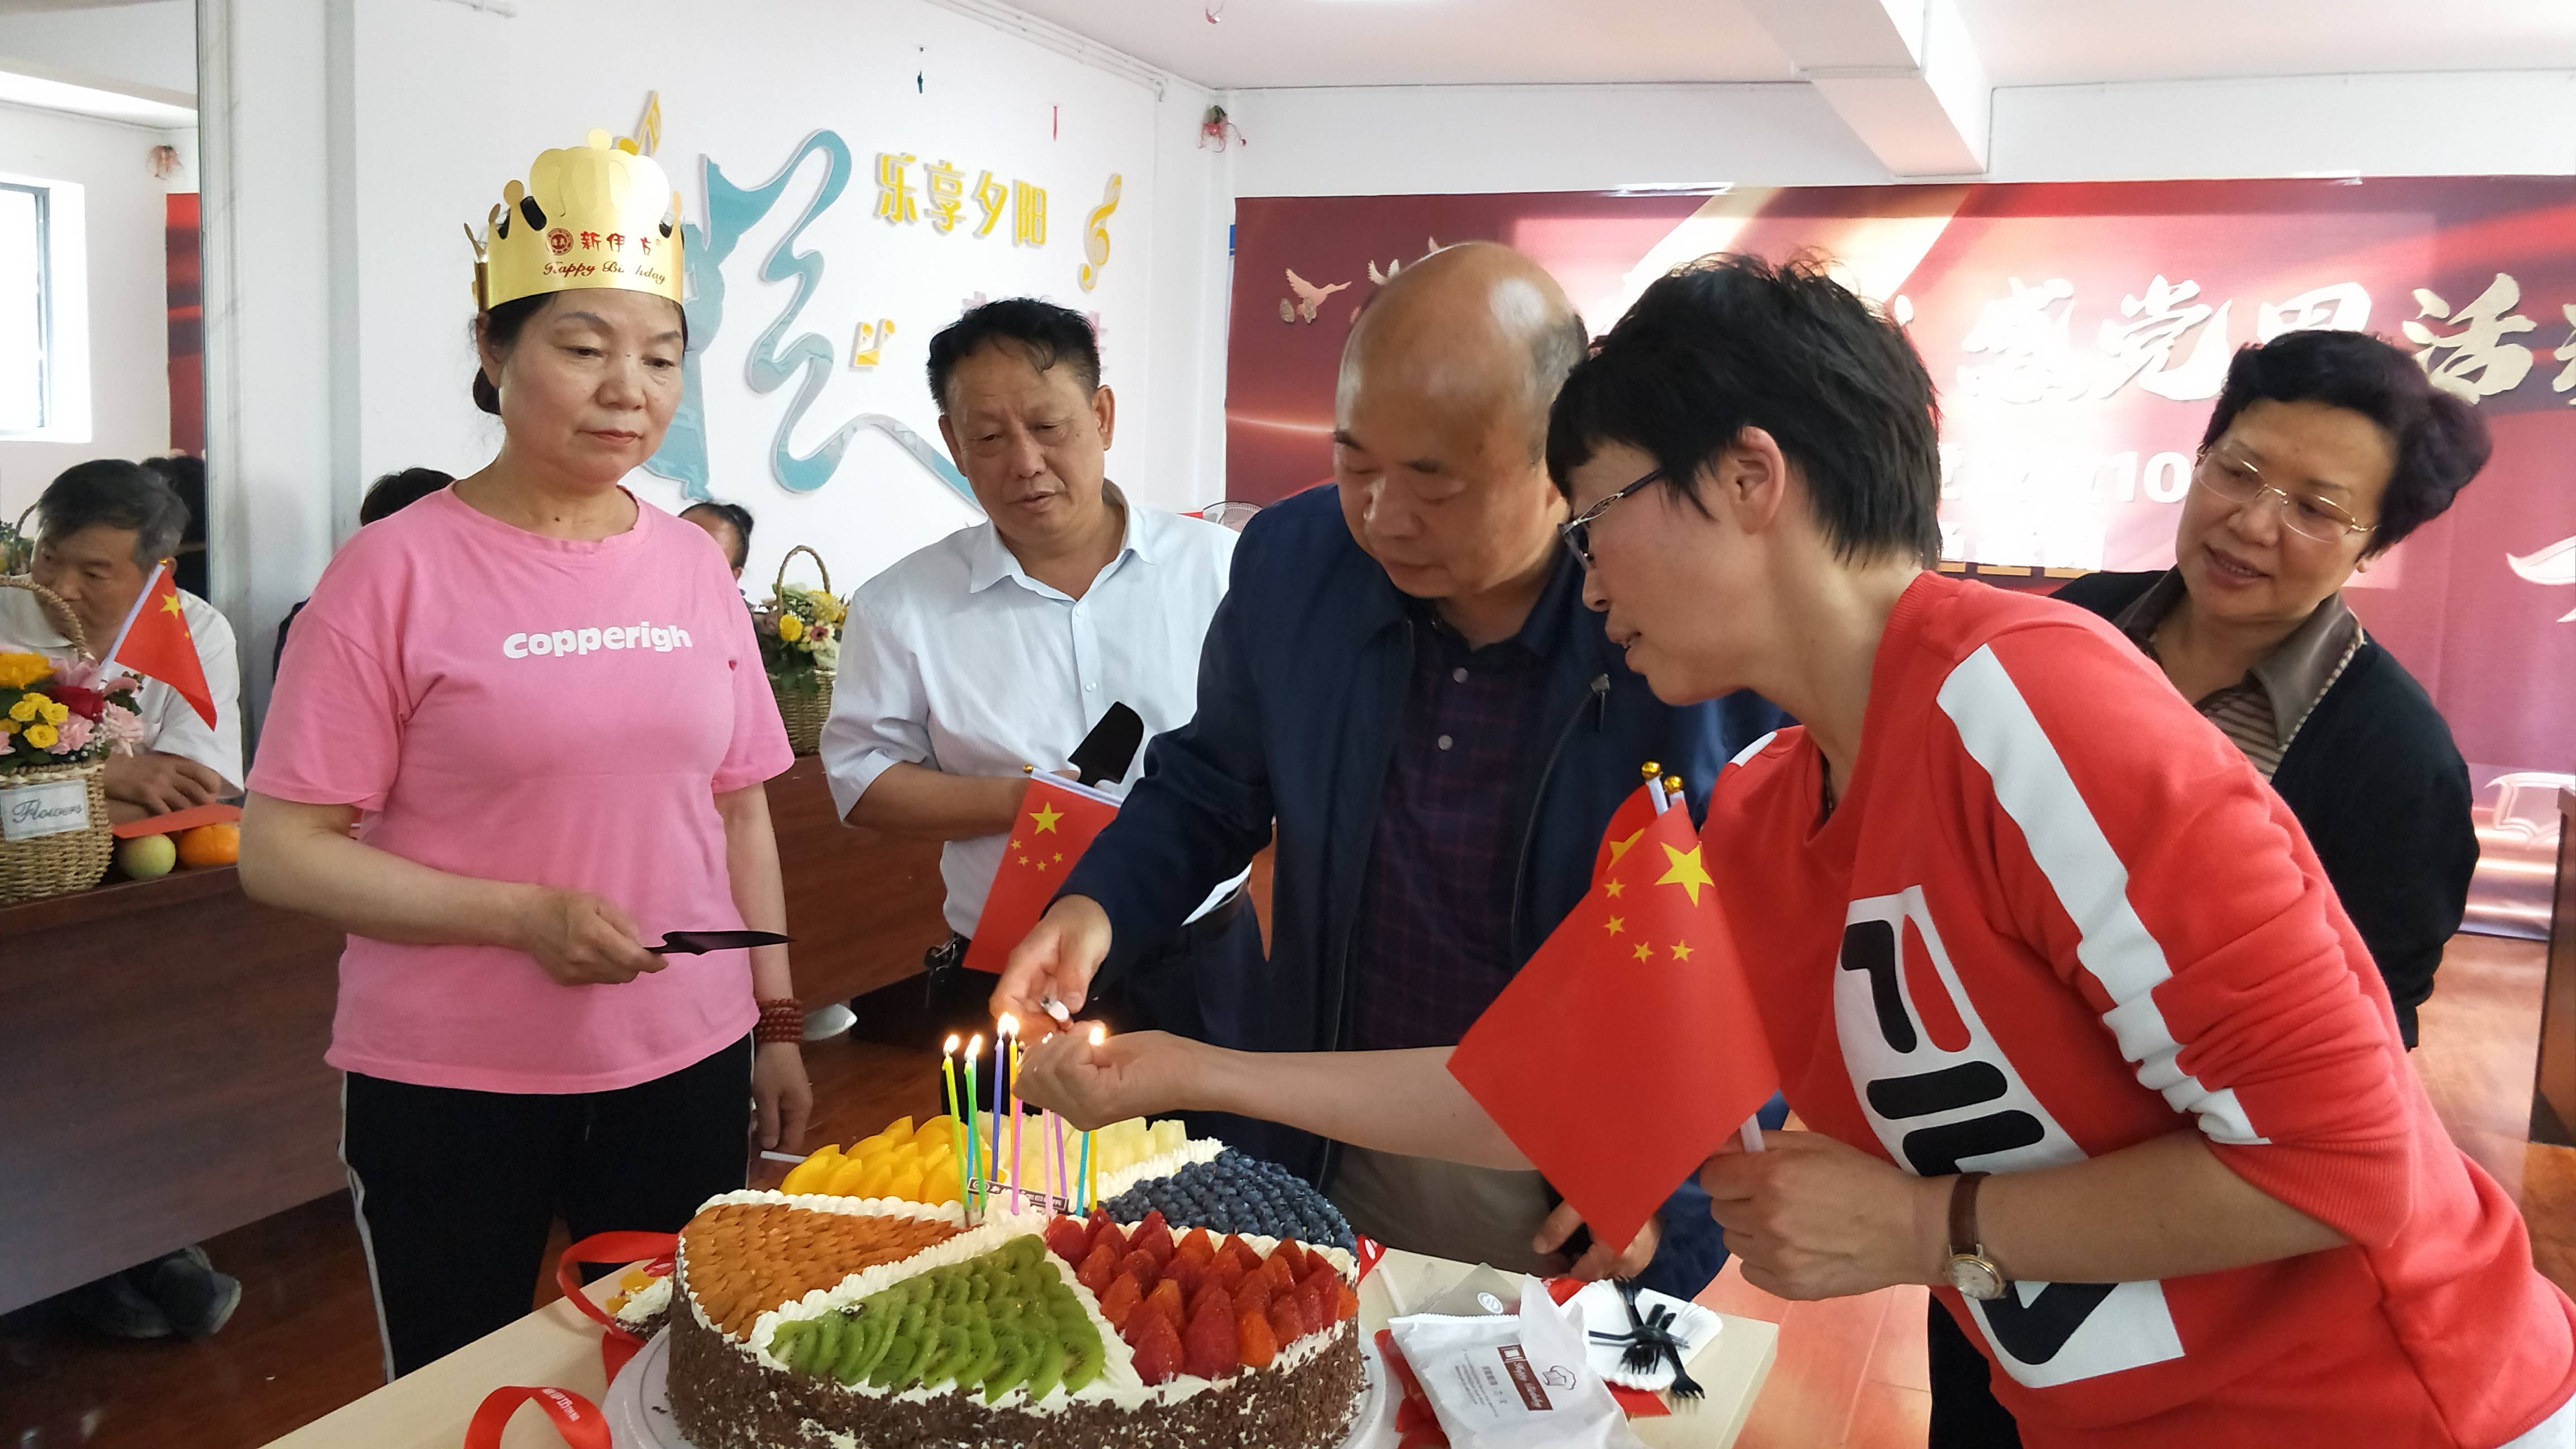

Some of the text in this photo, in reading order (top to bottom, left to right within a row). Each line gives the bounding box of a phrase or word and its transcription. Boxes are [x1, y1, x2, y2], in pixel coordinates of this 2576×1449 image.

[875, 152, 1048, 246] 乐享夕阳
[543, 261, 666, 285] Happy Bihday
[13, 798, 82, 823] Flowers
